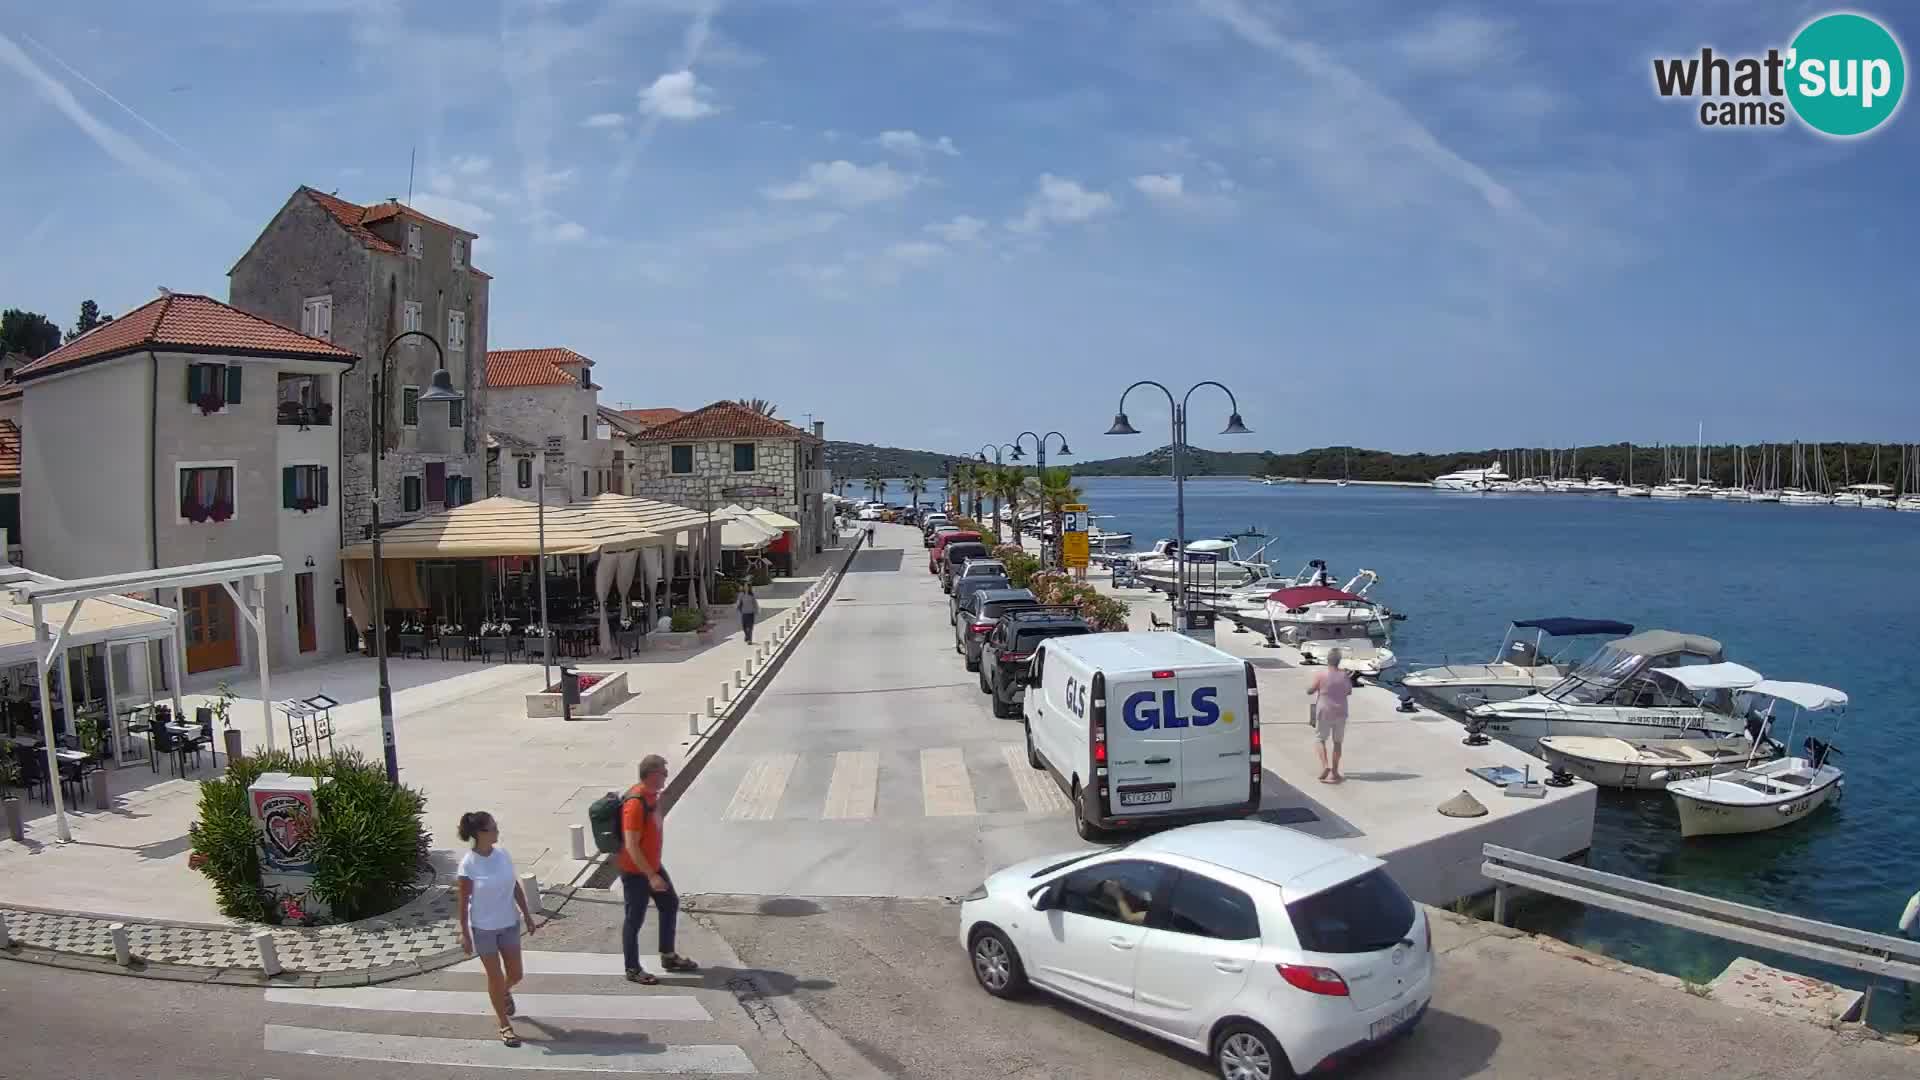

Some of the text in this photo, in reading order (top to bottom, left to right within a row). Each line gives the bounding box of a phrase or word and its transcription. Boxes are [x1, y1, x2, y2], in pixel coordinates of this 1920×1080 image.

[1065, 514, 1075, 529] P
[1066, 676, 1085, 718] GLS
[1122, 687, 1220, 731] GLS
[1661, 716, 1680, 727] RENT
